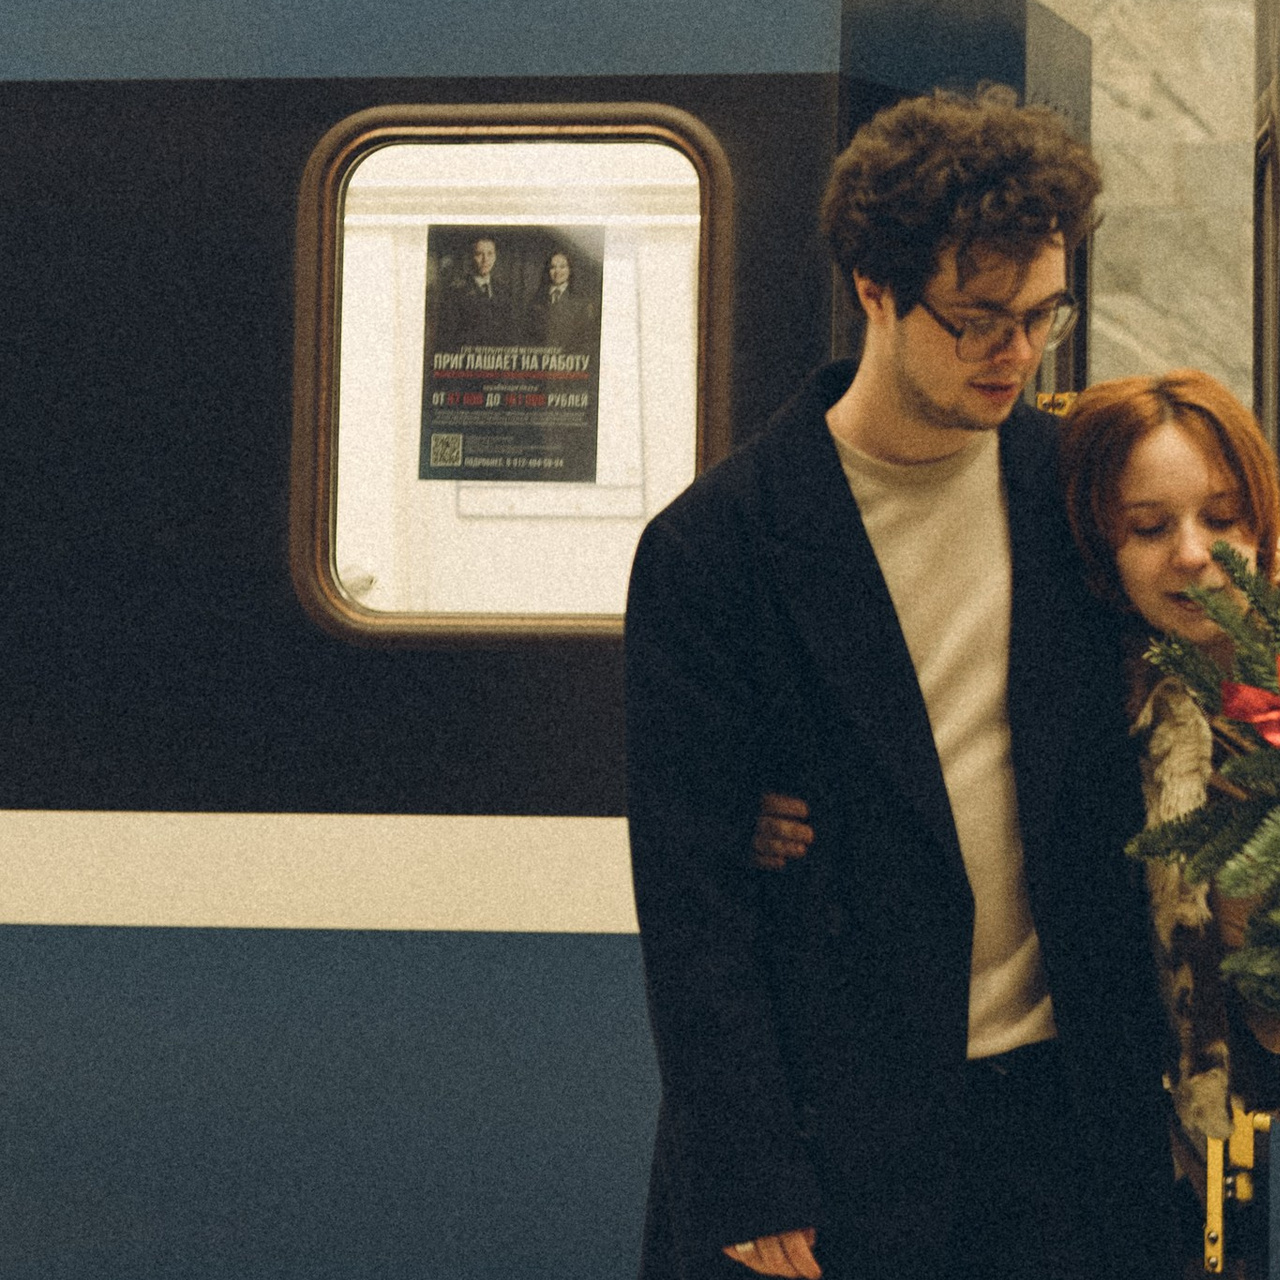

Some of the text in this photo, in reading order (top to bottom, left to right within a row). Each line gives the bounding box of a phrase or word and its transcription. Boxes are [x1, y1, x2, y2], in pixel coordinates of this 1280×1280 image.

[433, 353, 590, 371] ПРИГЛАШАЕТ НА РАБОТУ
[432, 392, 445, 406] ОТ
[485, 392, 501, 407] ДО
[547, 392, 588, 408] РУБЛЕЙ
